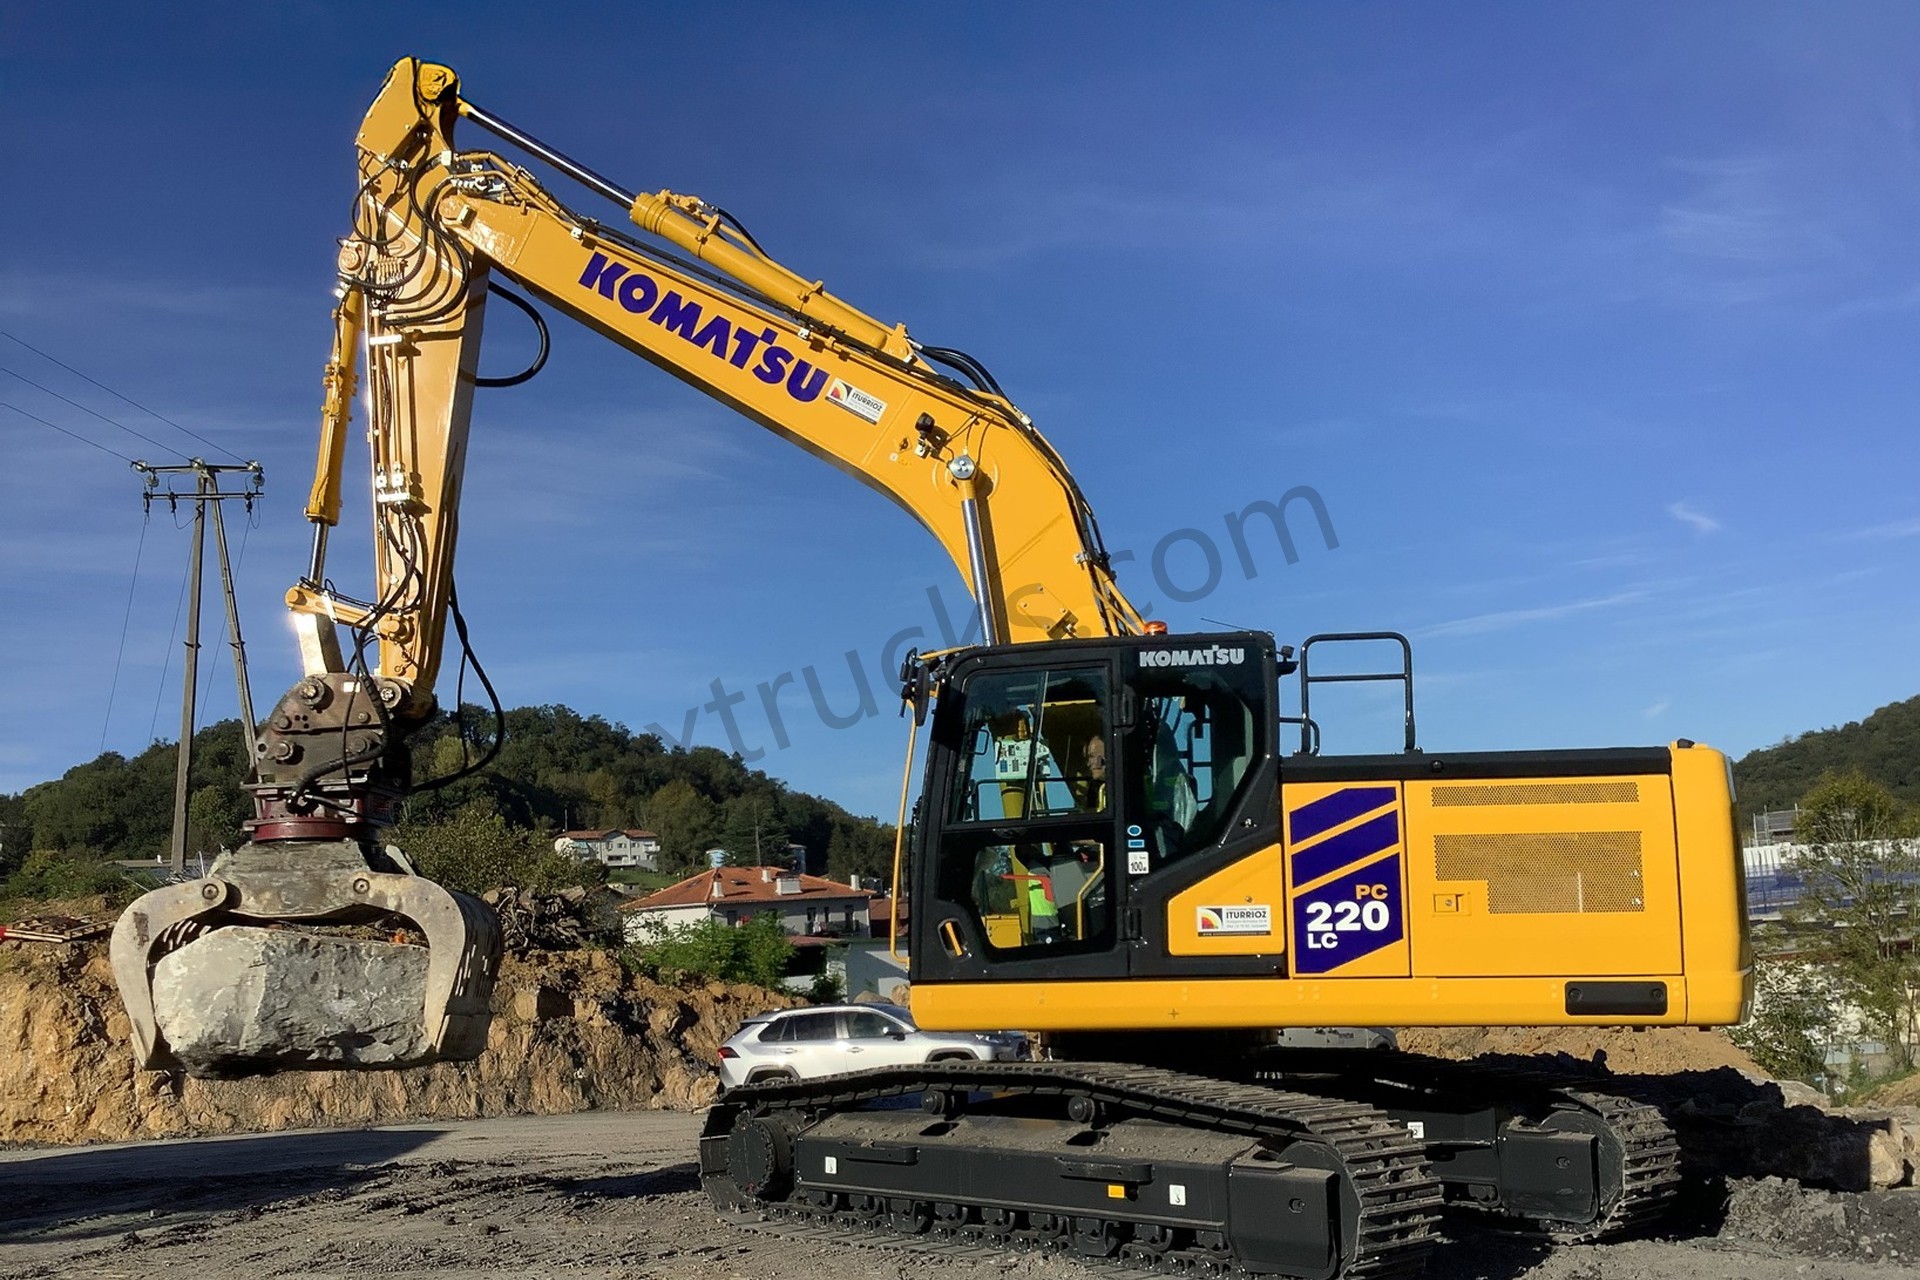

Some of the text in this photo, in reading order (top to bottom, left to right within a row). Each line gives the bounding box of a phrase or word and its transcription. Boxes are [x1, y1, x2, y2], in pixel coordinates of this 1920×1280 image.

[578, 250, 830, 403] KOMATSU
[851, 392, 883, 412] ITURRIOZ
[1139, 645, 1245, 667] KOMATSU
[1355, 884, 1389, 900] PC
[1226, 910, 1267, 919] ITURRIOZ
[1306, 900, 1390, 932] 220
[1307, 932, 1339, 949] LC
